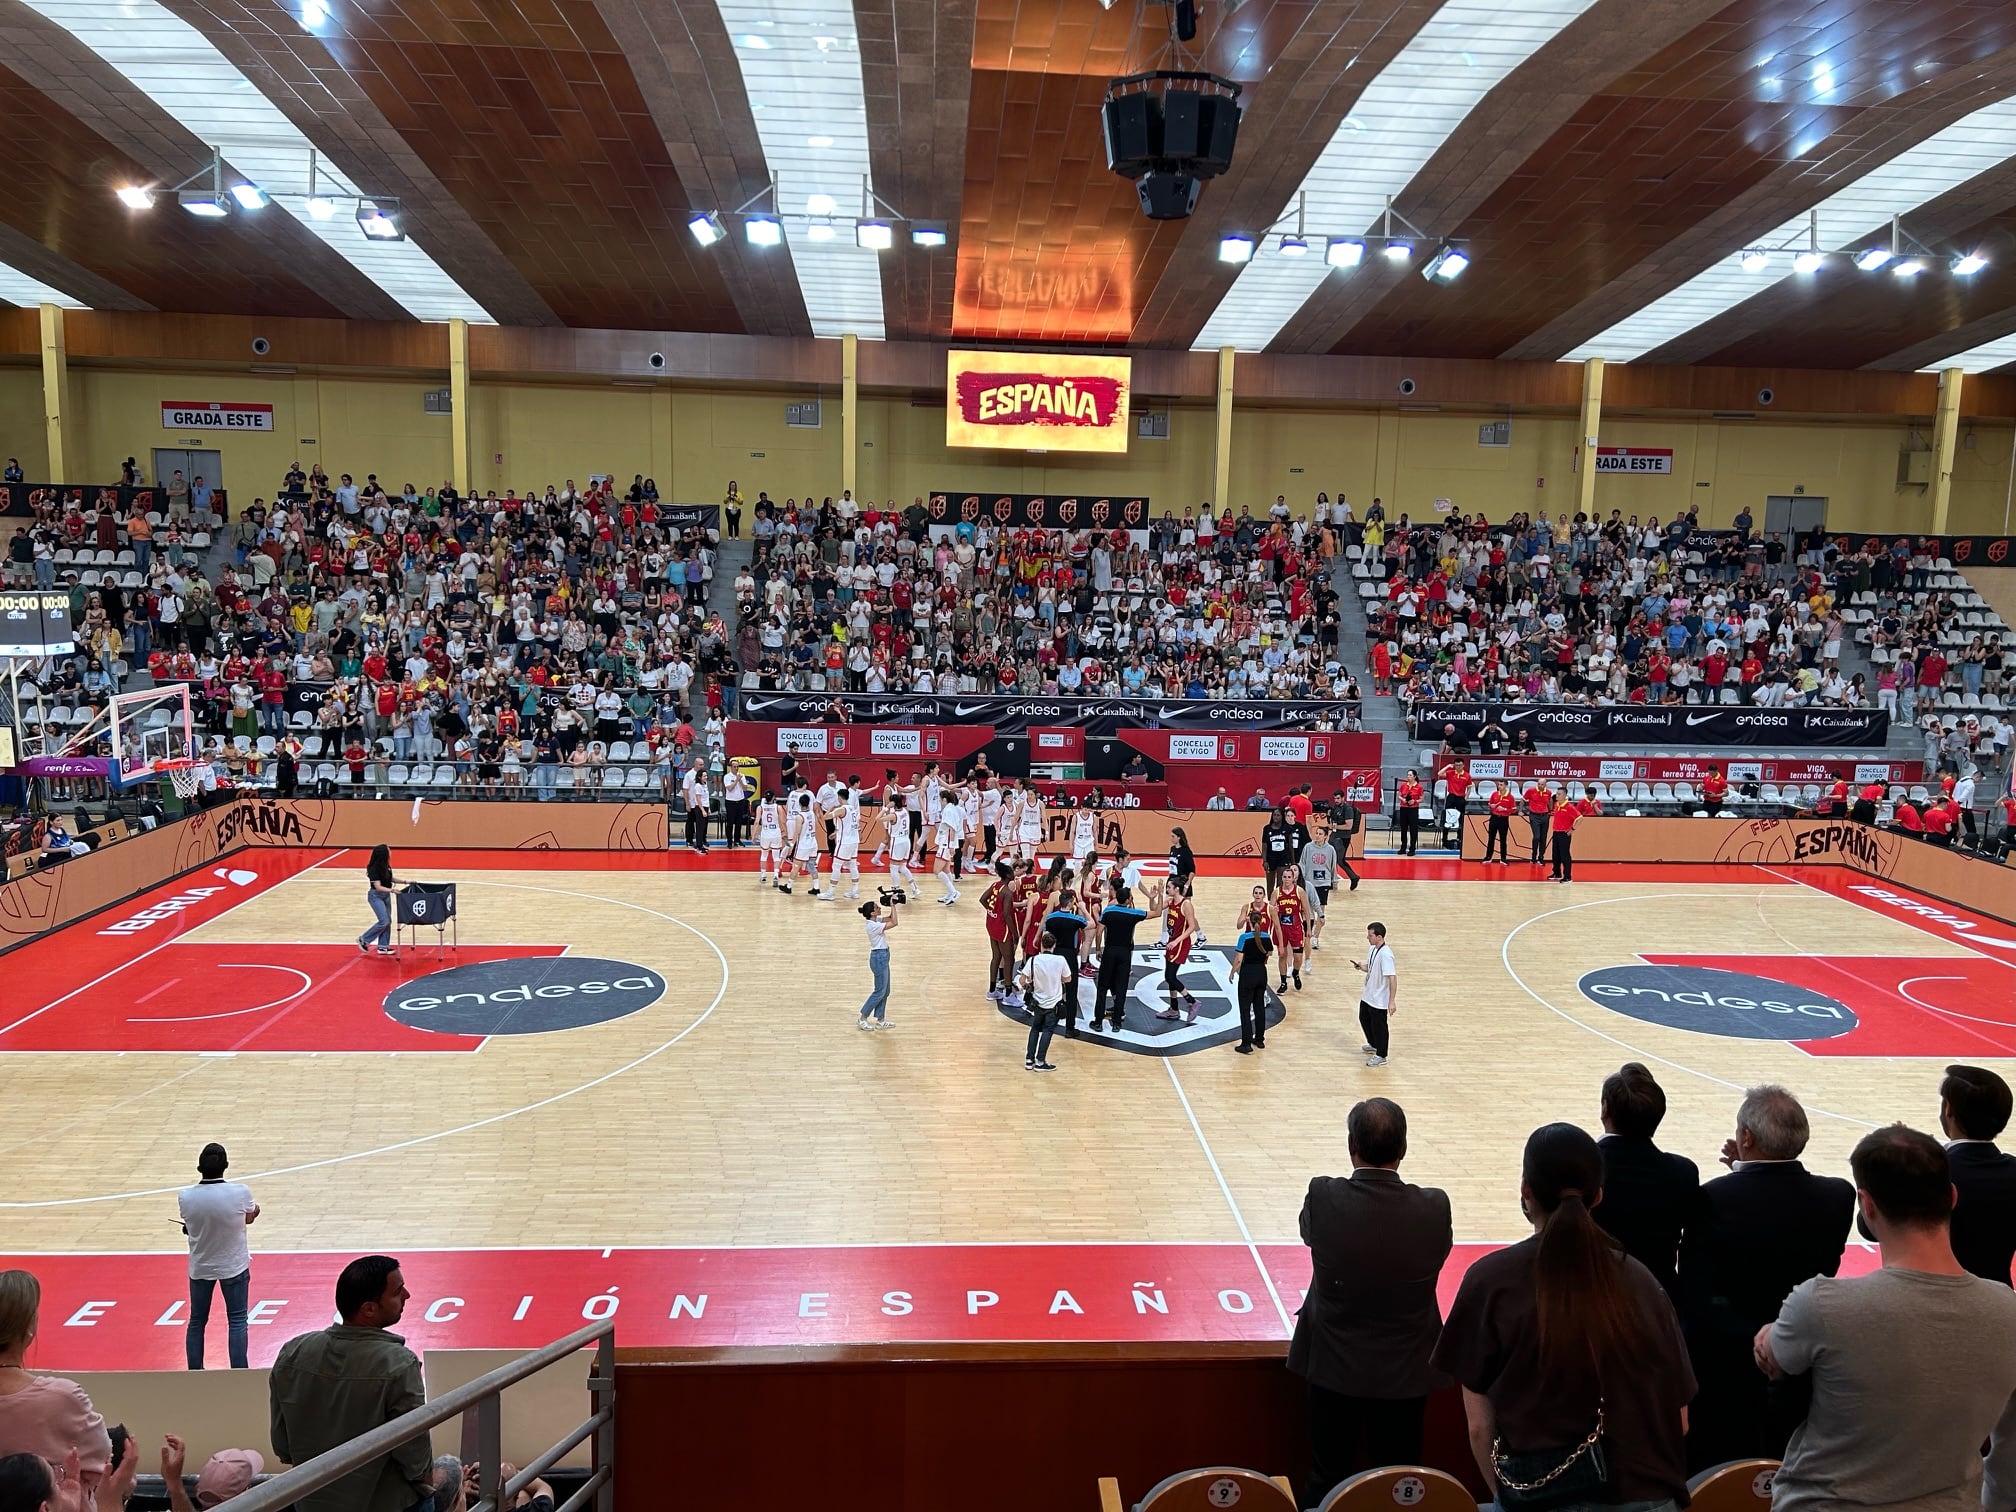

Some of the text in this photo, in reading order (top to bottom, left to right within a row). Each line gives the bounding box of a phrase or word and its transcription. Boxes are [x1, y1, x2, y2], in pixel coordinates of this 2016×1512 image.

[979, 380, 1099, 425] ESPAÑA
[173, 412, 263, 427] GRADA ESTE
[1594, 457, 1663, 470] RADA ESTE
[42, 596, 70, 609] 00:00
[799, 699, 854, 713] enda
[890, 704, 934, 715] CaixaBank
[1006, 702, 1060, 716] endesa
[1096, 706, 1138, 718] CaixaBank
[1210, 707, 1263, 720] endesa
[1299, 709, 1342, 720] Caixaank
[1438, 711, 1481, 722] CaixaBank
[1537, 710, 1592, 724] endesa
[1625, 712, 1667, 724] CaixaBank
[1736, 712, 1788, 726] endesa
[1822, 717, 1864, 728] CaixaBank
[780, 732, 824, 741] CONCELLO
[874, 734, 917, 742] CONCELLO
[895, 742, 912, 750] VIGO
[1172, 739, 1214, 748] CONCELLO
[1263, 741, 1305, 749] CONCELLO
[1177, 747, 1209, 755] DE VIGO
[44, 763, 72, 774] renfe
[1551, 760, 1571, 771] VIGO,
[1679, 763, 1699, 773] VIGO,
[1806, 764, 1827, 774] VIGO,
[1533, 767, 1587, 777] terreo de xogo
[1662, 770, 1685, 778] terreo
[1685, 771, 1696, 779] de
[1790, 771, 1812, 779] terreo
[1813, 772, 1824, 780] de
[766, 813, 773, 823] 6
[216, 800, 304, 853] ESPAÑA
[808, 821, 813, 831] 5
[902, 819, 907, 829] 9
[1793, 826, 1879, 872] ESPAÑA
[95, 886, 227, 935] IBERIA
[1847, 885, 1978, 930] IBERIA
[1141, 953, 1211, 964] FB
[399, 976, 656, 1011] endesa
[1590, 984, 1843, 1019] endesa
[64, 1286, 708, 1327] ELECIÓN
[1220, 1488, 1229, 1500] 9
[1404, 1486, 1413, 1498] 8
